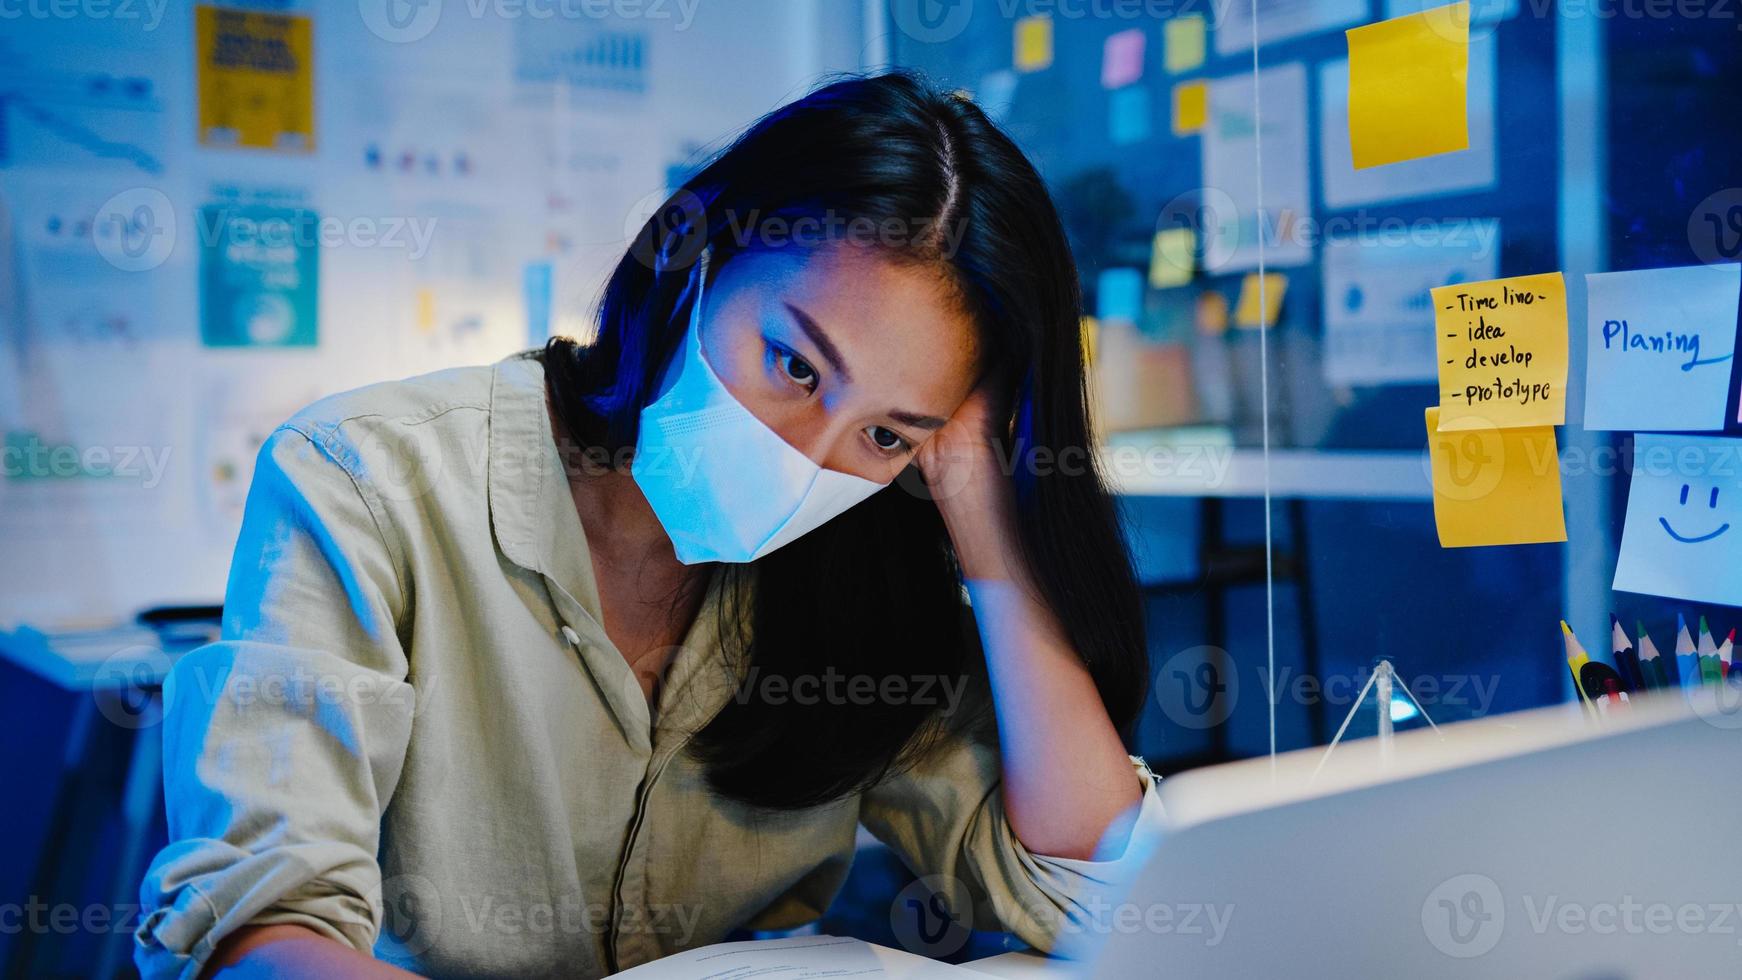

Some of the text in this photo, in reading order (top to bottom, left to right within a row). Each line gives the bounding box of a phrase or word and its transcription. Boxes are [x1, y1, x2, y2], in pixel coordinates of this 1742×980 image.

[1468, 316, 1505, 341] idea
[1466, 345, 1532, 368] develop
[1603, 319, 1734, 372] Planing
